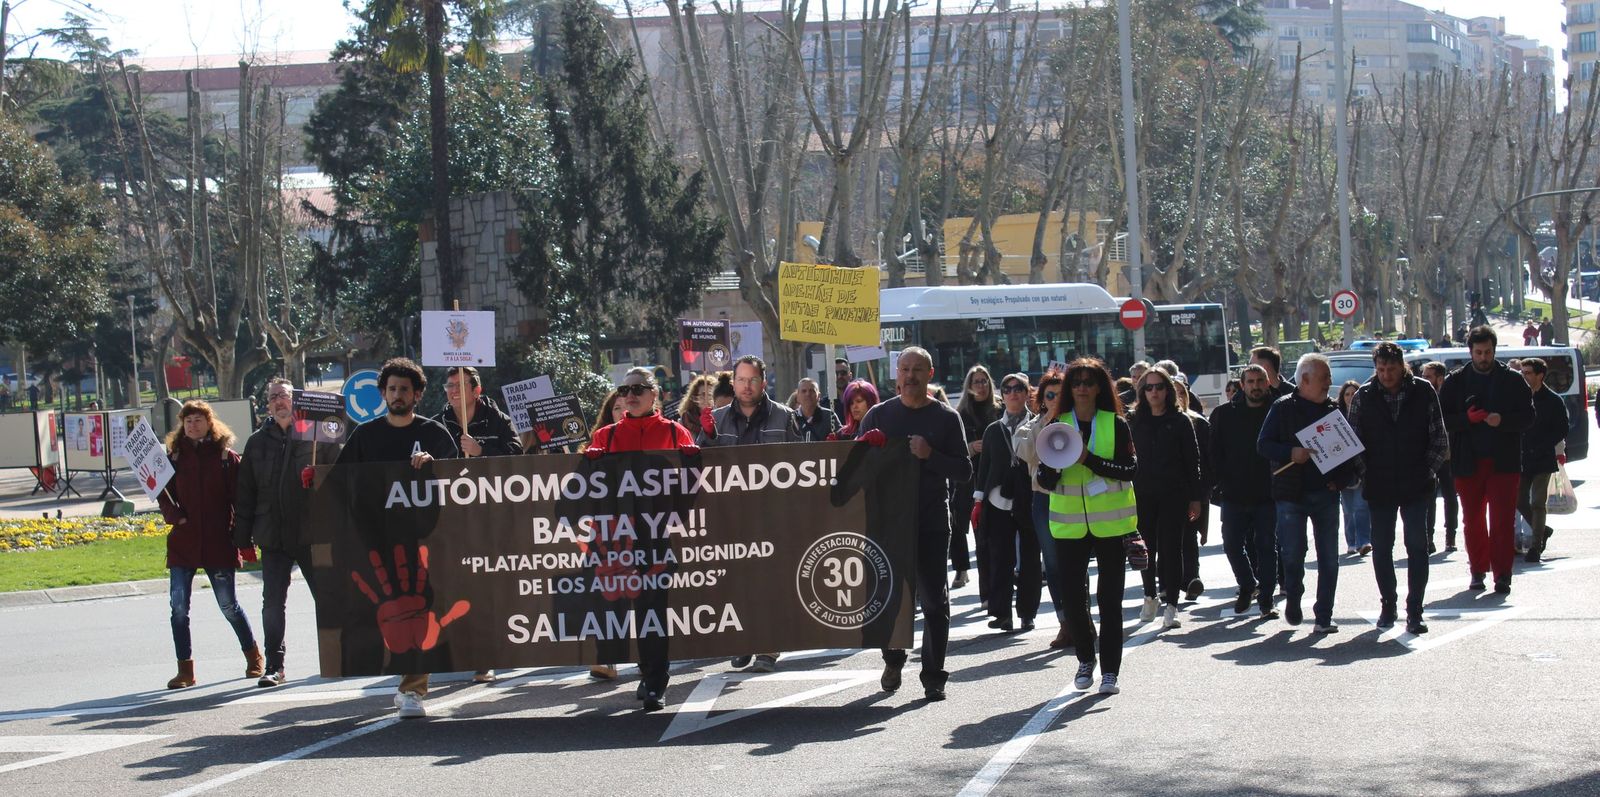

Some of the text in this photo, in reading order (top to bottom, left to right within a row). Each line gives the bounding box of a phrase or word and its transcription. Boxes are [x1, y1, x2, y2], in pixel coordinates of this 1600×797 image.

[782, 283, 857, 304] ADEMÁS DE
[970, 296, 979, 305] Soy
[1050, 294, 1067, 302] natural
[782, 301, 820, 317] PUTAS
[1338, 299, 1352, 309] 30
[784, 320, 798, 332] LA
[714, 350, 724, 358] 30
[506, 381, 537, 395] TRABAJO
[508, 393, 527, 403] PARA
[328, 422, 338, 430] 30
[568, 422, 578, 431] 30
[125, 424, 146, 452] TRABAJO
[1312, 435, 1325, 454] España
[133, 438, 156, 468] VIDA DIGNA
[385, 458, 838, 508] AUTÓNOMOS ASFIXIADOS!!
[533, 508, 707, 544] BASTA YA!!
[462, 542, 774, 573] “PLATAFORMA POR LA DIGNIDAD
[801, 537, 888, 580] MANIFESTACION NACIONAL
[823, 556, 864, 588] 30
[519, 569, 726, 596] DE LOS AUTÓNOMOS”
[837, 589, 852, 607] N
[809, 600, 882, 624] DE AUTONOMOS
[508, 603, 744, 644] SALAMANCA
